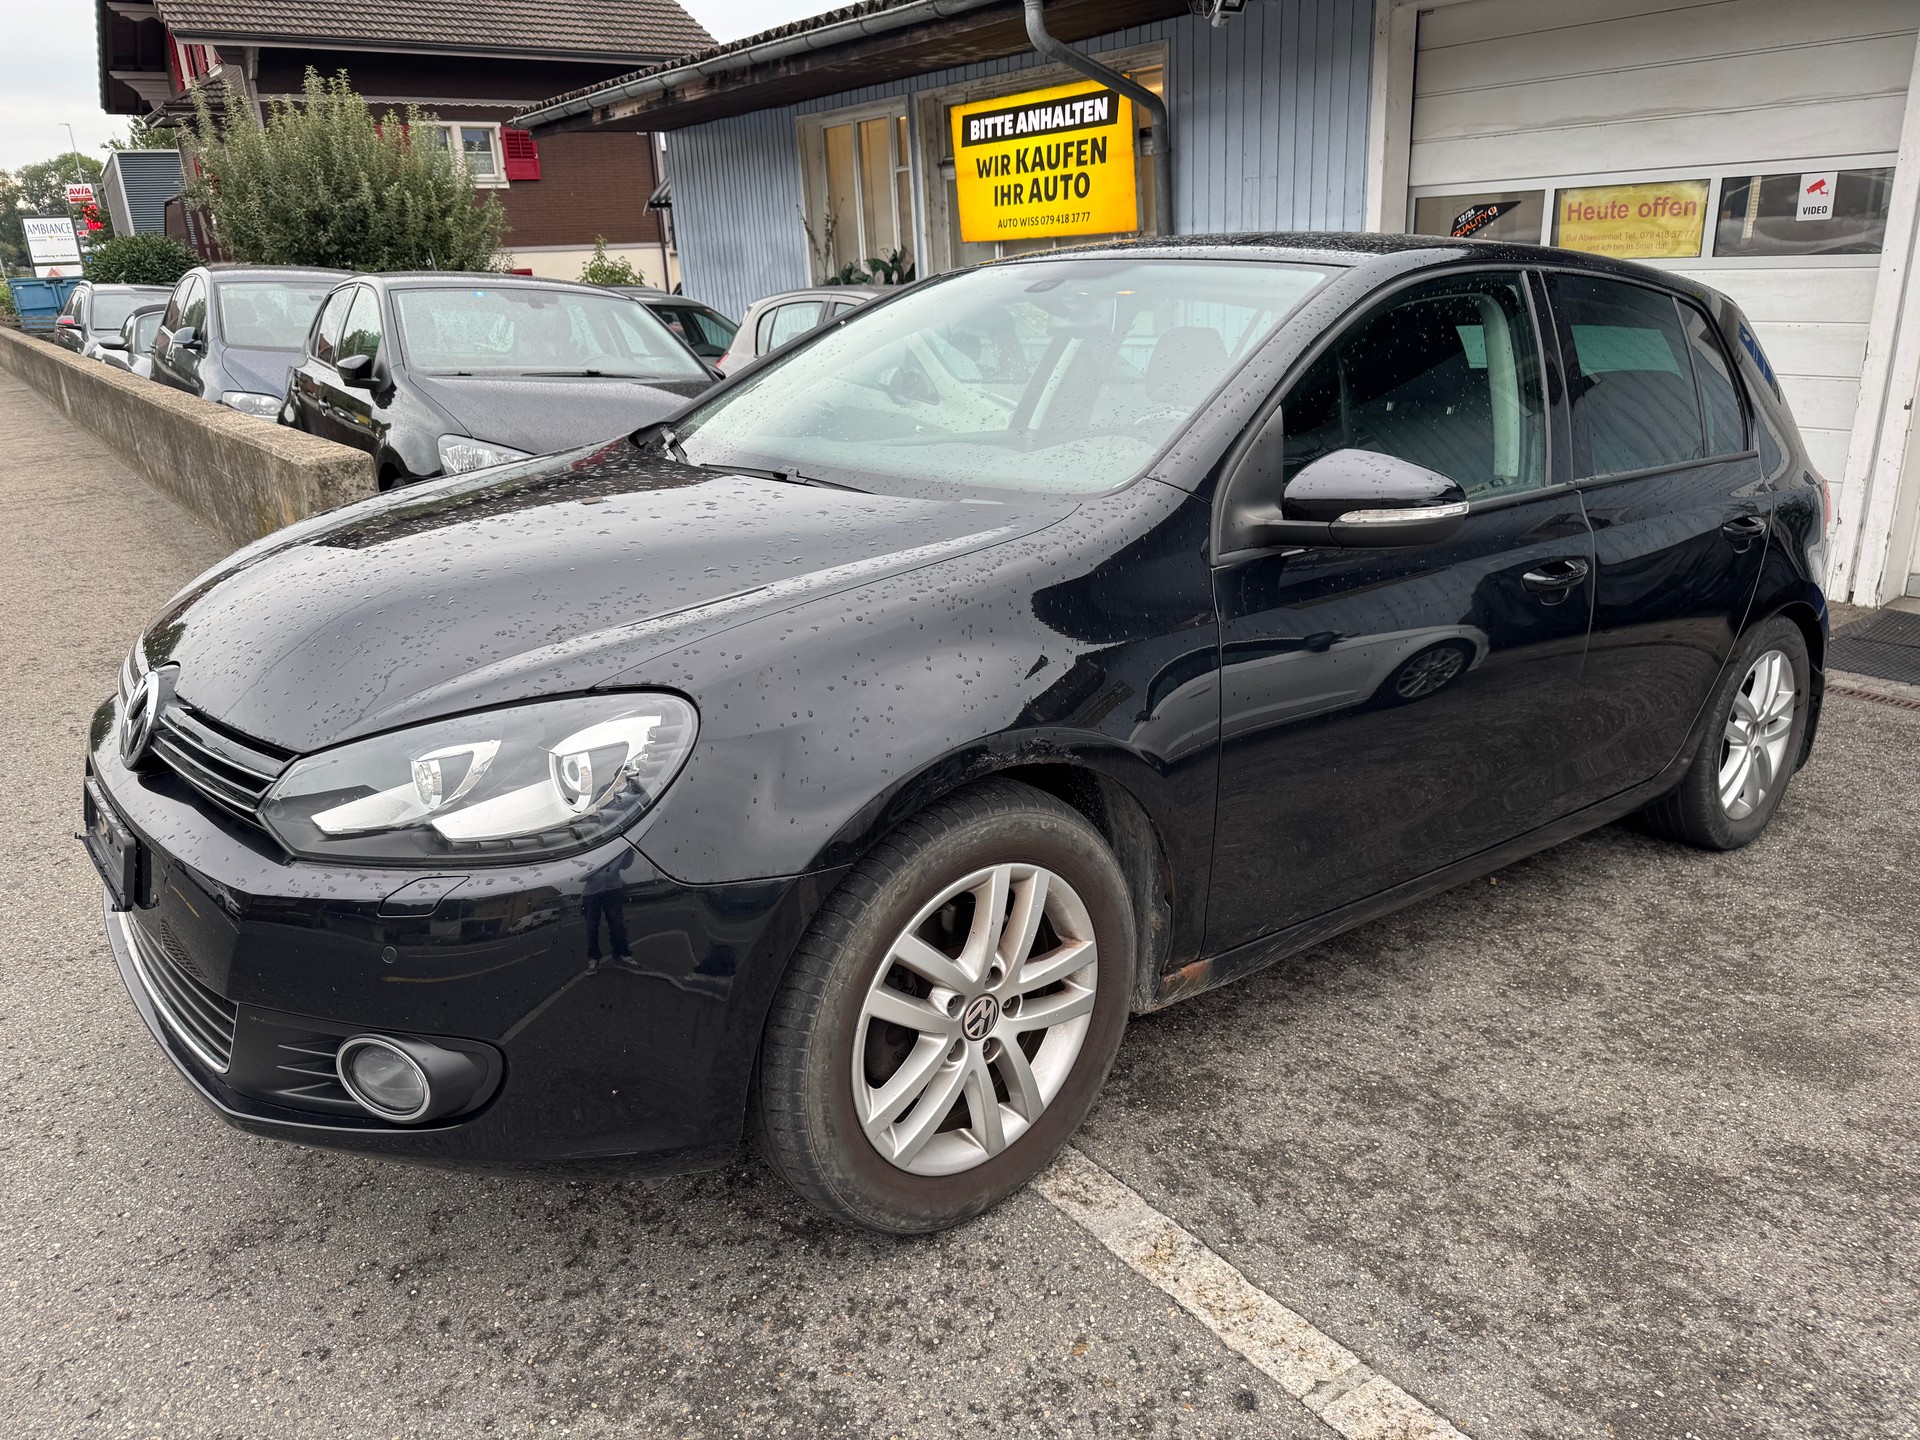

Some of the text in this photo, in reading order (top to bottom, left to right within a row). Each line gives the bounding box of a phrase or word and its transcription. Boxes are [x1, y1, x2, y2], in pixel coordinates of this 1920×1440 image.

[970, 97, 1109, 141] BITTE ANHALTEN
[976, 136, 1108, 179] WIR KAUFEN
[994, 172, 1091, 207] IHR AUTO
[1458, 208, 1475, 223] 12/24
[1567, 196, 1697, 222] Heute offen
[1802, 205, 1828, 215] VIDEO
[27, 222, 72, 235] AMBIANCE
[998, 218, 1018, 229] AUTO
[1020, 216, 1039, 227] WISS
[1040, 215, 1055, 225] 079
[1056, 213, 1069, 224] 418
[1453, 211, 1488, 238] QUALITY
[1566, 230, 1695, 242] Bei Abwesenheit Tel. 079 418 37 77
[1626, 242, 1633, 250] in
